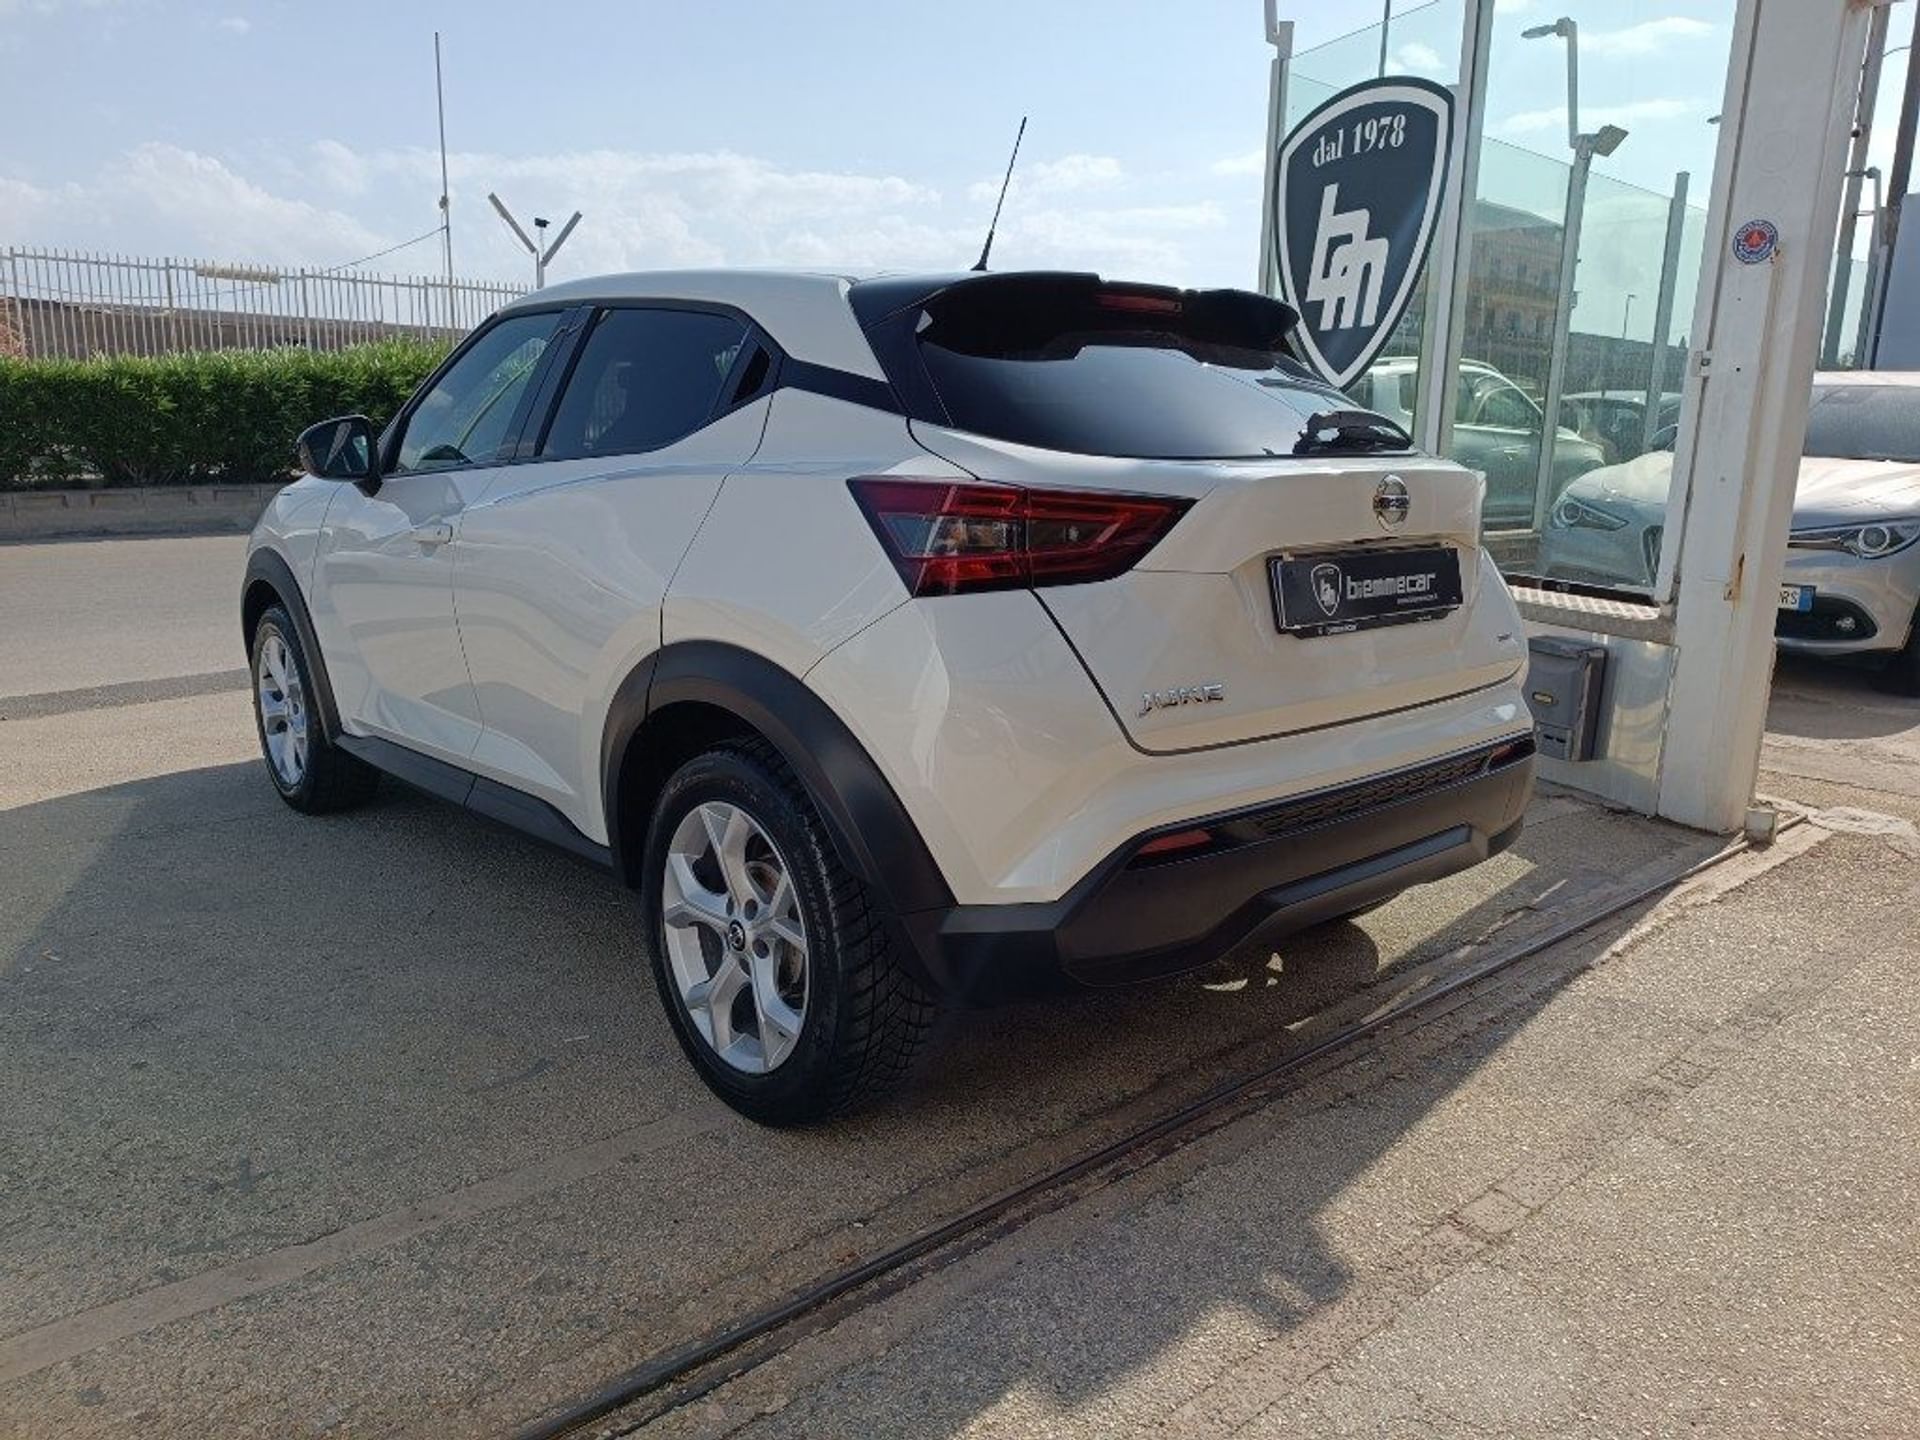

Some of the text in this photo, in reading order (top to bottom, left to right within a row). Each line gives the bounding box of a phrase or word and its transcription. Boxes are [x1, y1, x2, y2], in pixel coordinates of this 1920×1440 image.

[1312, 114, 1406, 168] dal 1978
[1779, 590, 1798, 605] RS
[1139, 684, 1223, 717] JUKE
